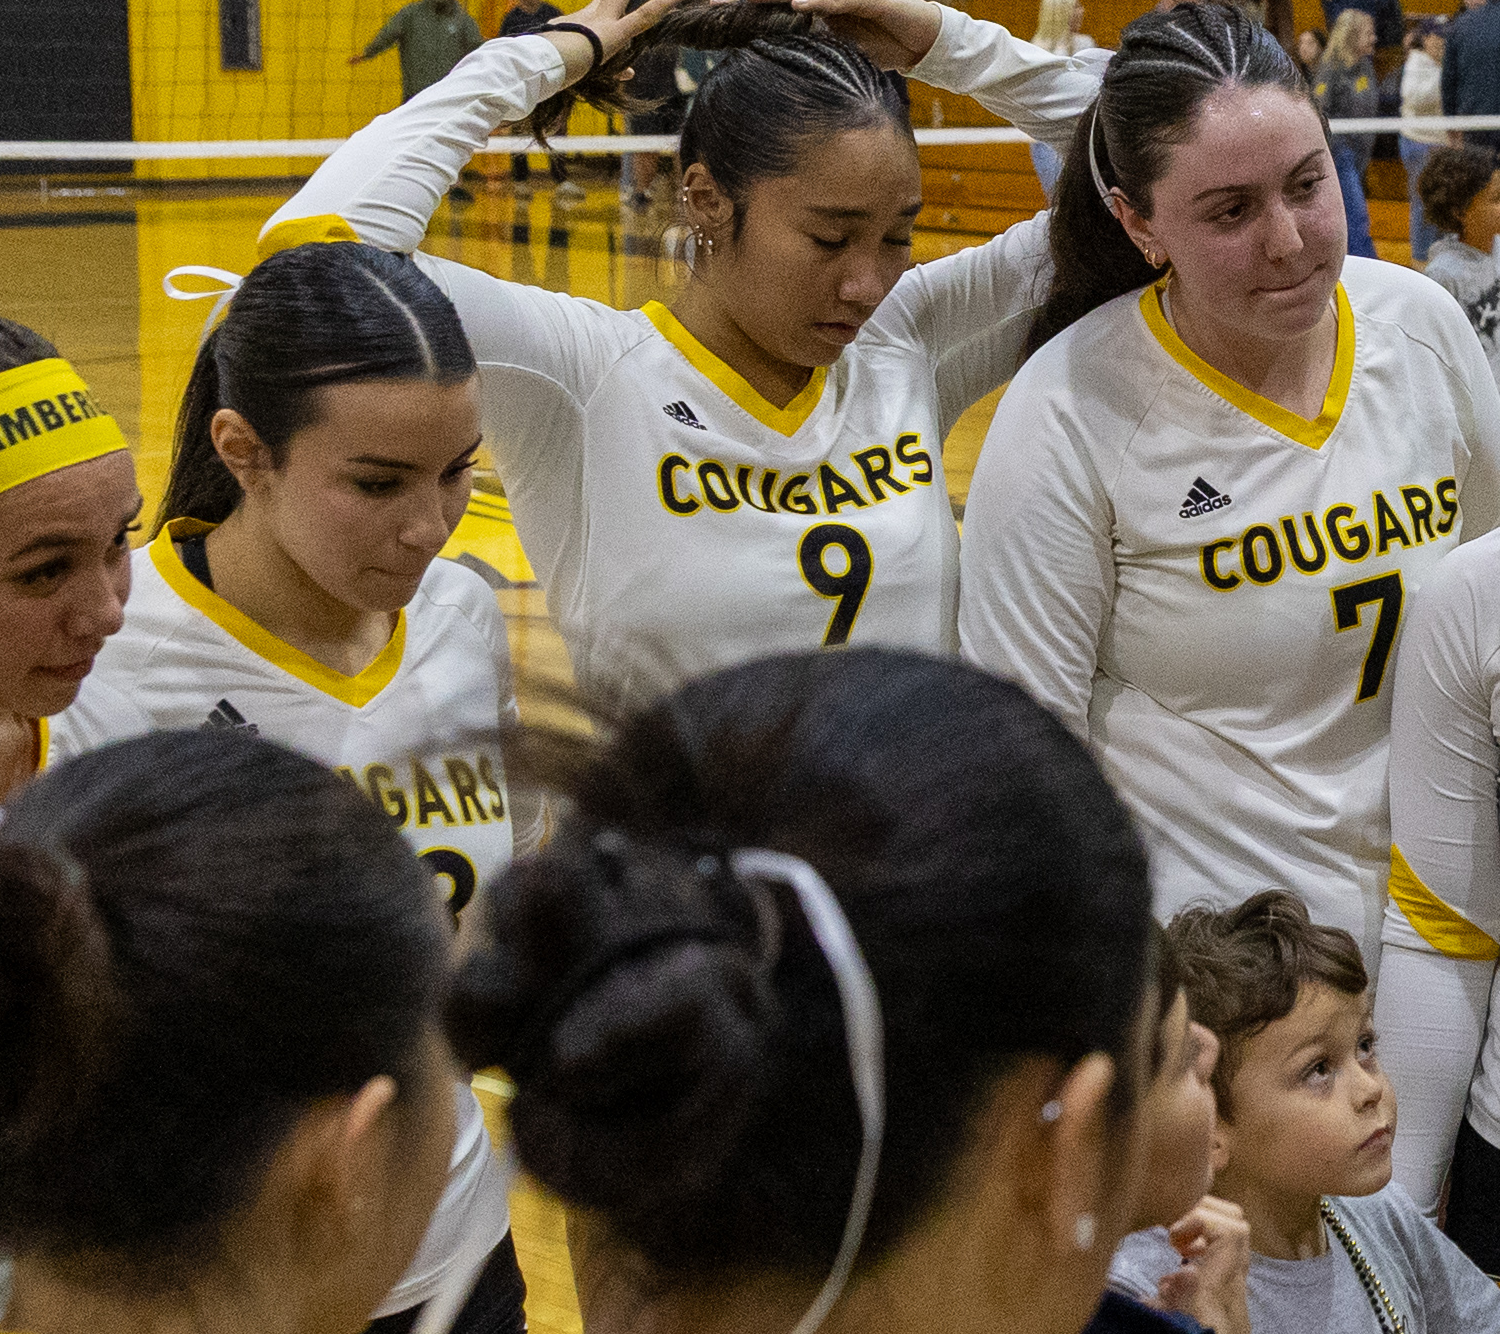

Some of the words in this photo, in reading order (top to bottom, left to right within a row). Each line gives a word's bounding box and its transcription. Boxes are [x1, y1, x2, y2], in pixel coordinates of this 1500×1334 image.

[657, 432, 933, 517] COUGARS
[1179, 493, 1232, 518] adidas
[797, 522, 875, 649] 9
[1199, 476, 1458, 593] COUGARS
[1329, 569, 1405, 704] 7
